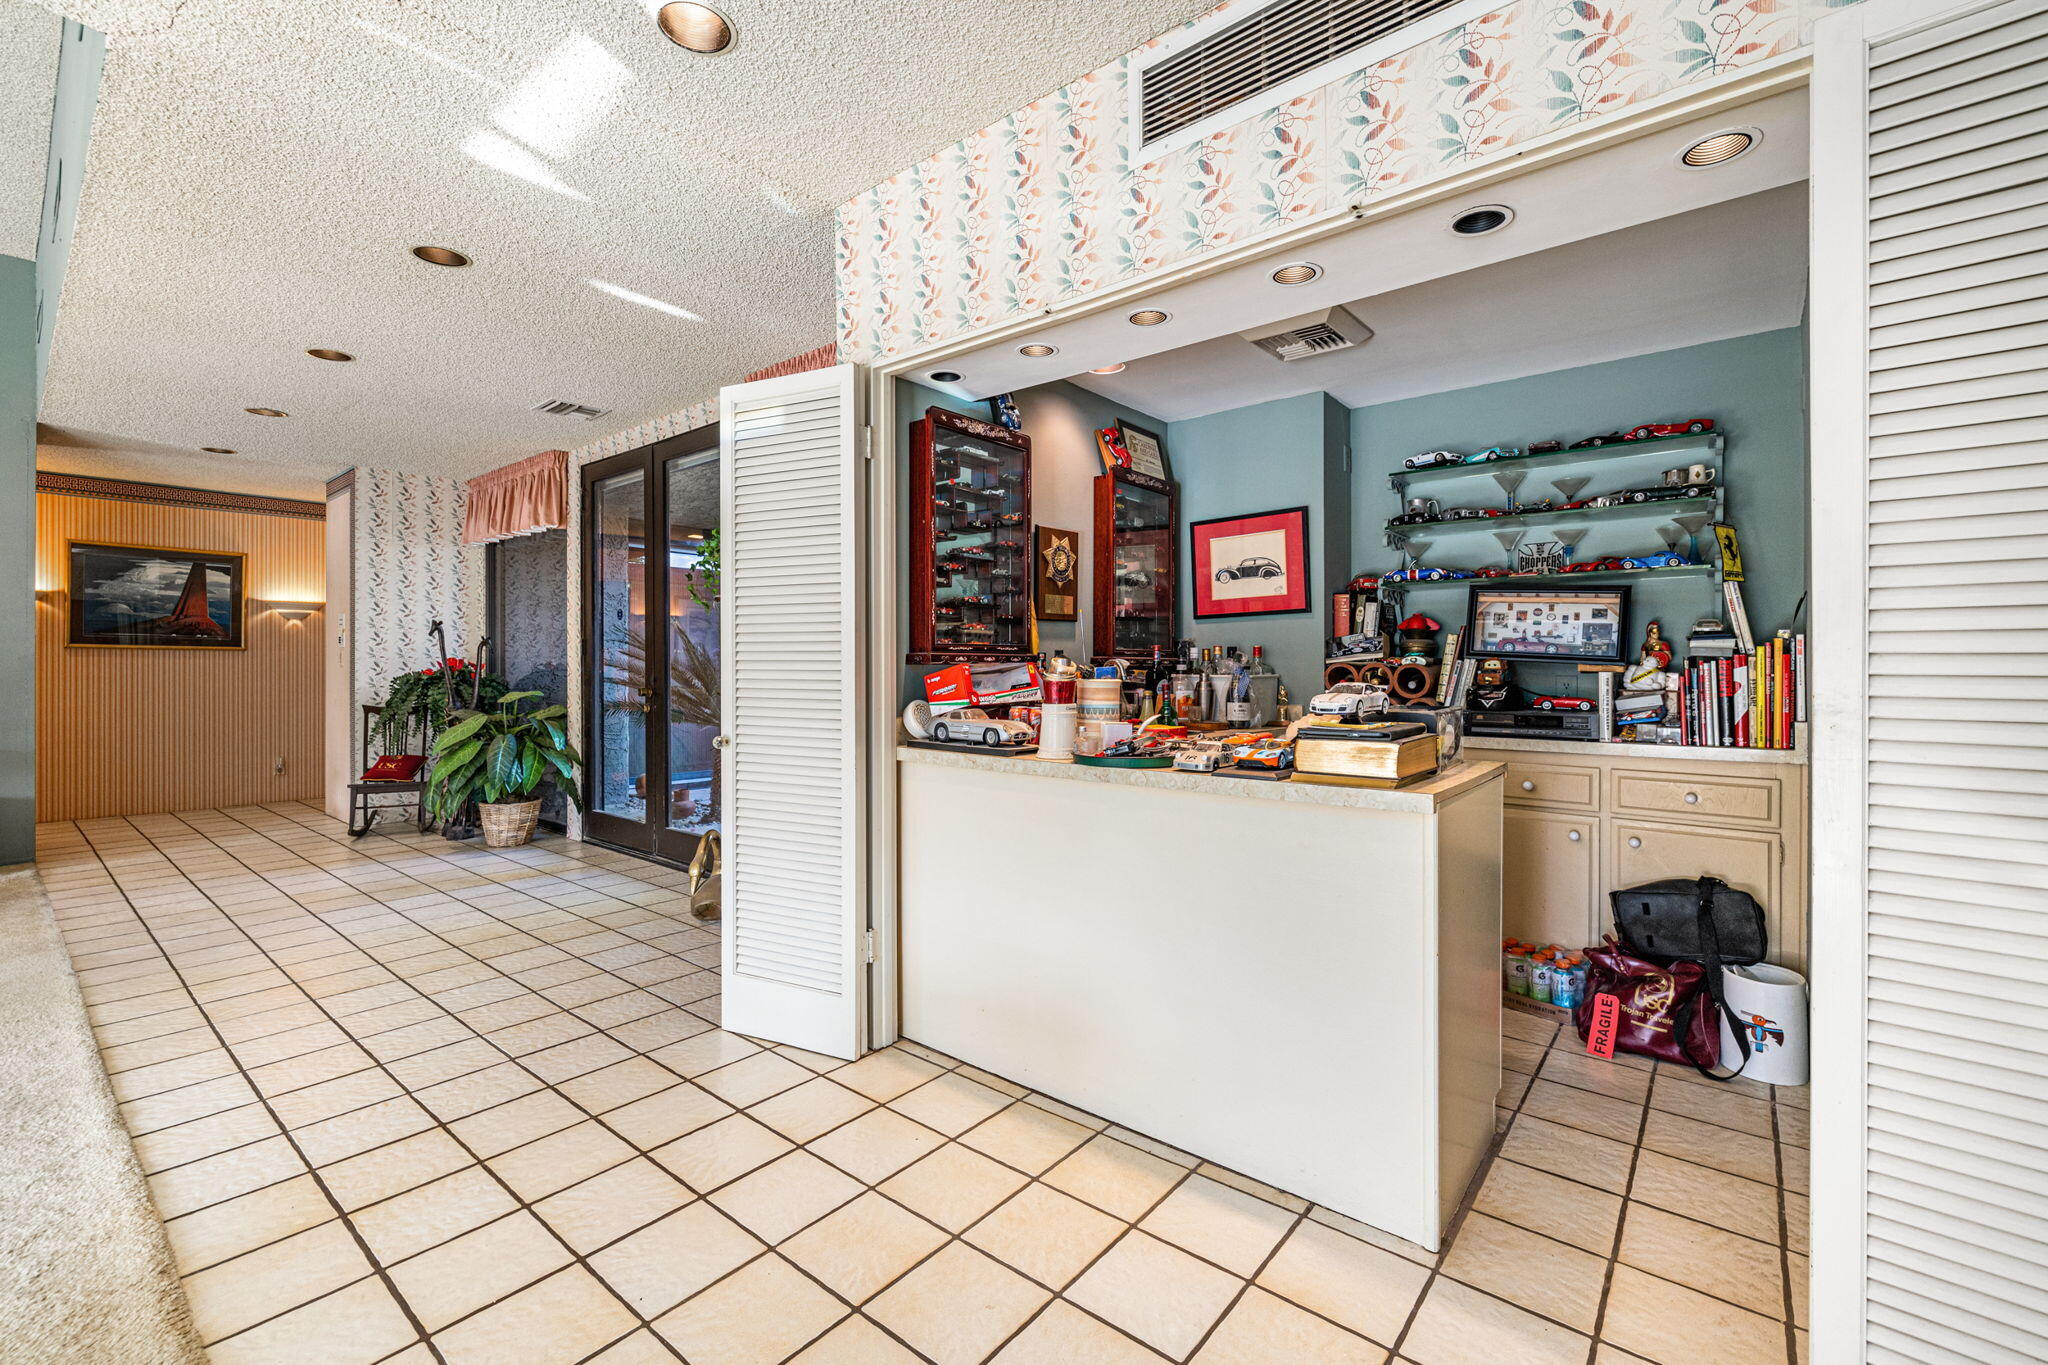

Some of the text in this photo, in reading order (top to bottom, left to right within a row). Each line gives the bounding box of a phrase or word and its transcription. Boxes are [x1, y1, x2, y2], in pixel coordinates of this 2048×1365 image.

[1520, 553, 1562, 571] CHOPPERS
[1516, 965, 1525, 973] G
[1538, 972, 1546, 980] G
[1620, 1004, 1674, 1025] Trojan Travele
[1593, 998, 1613, 1055] FRAGILE
